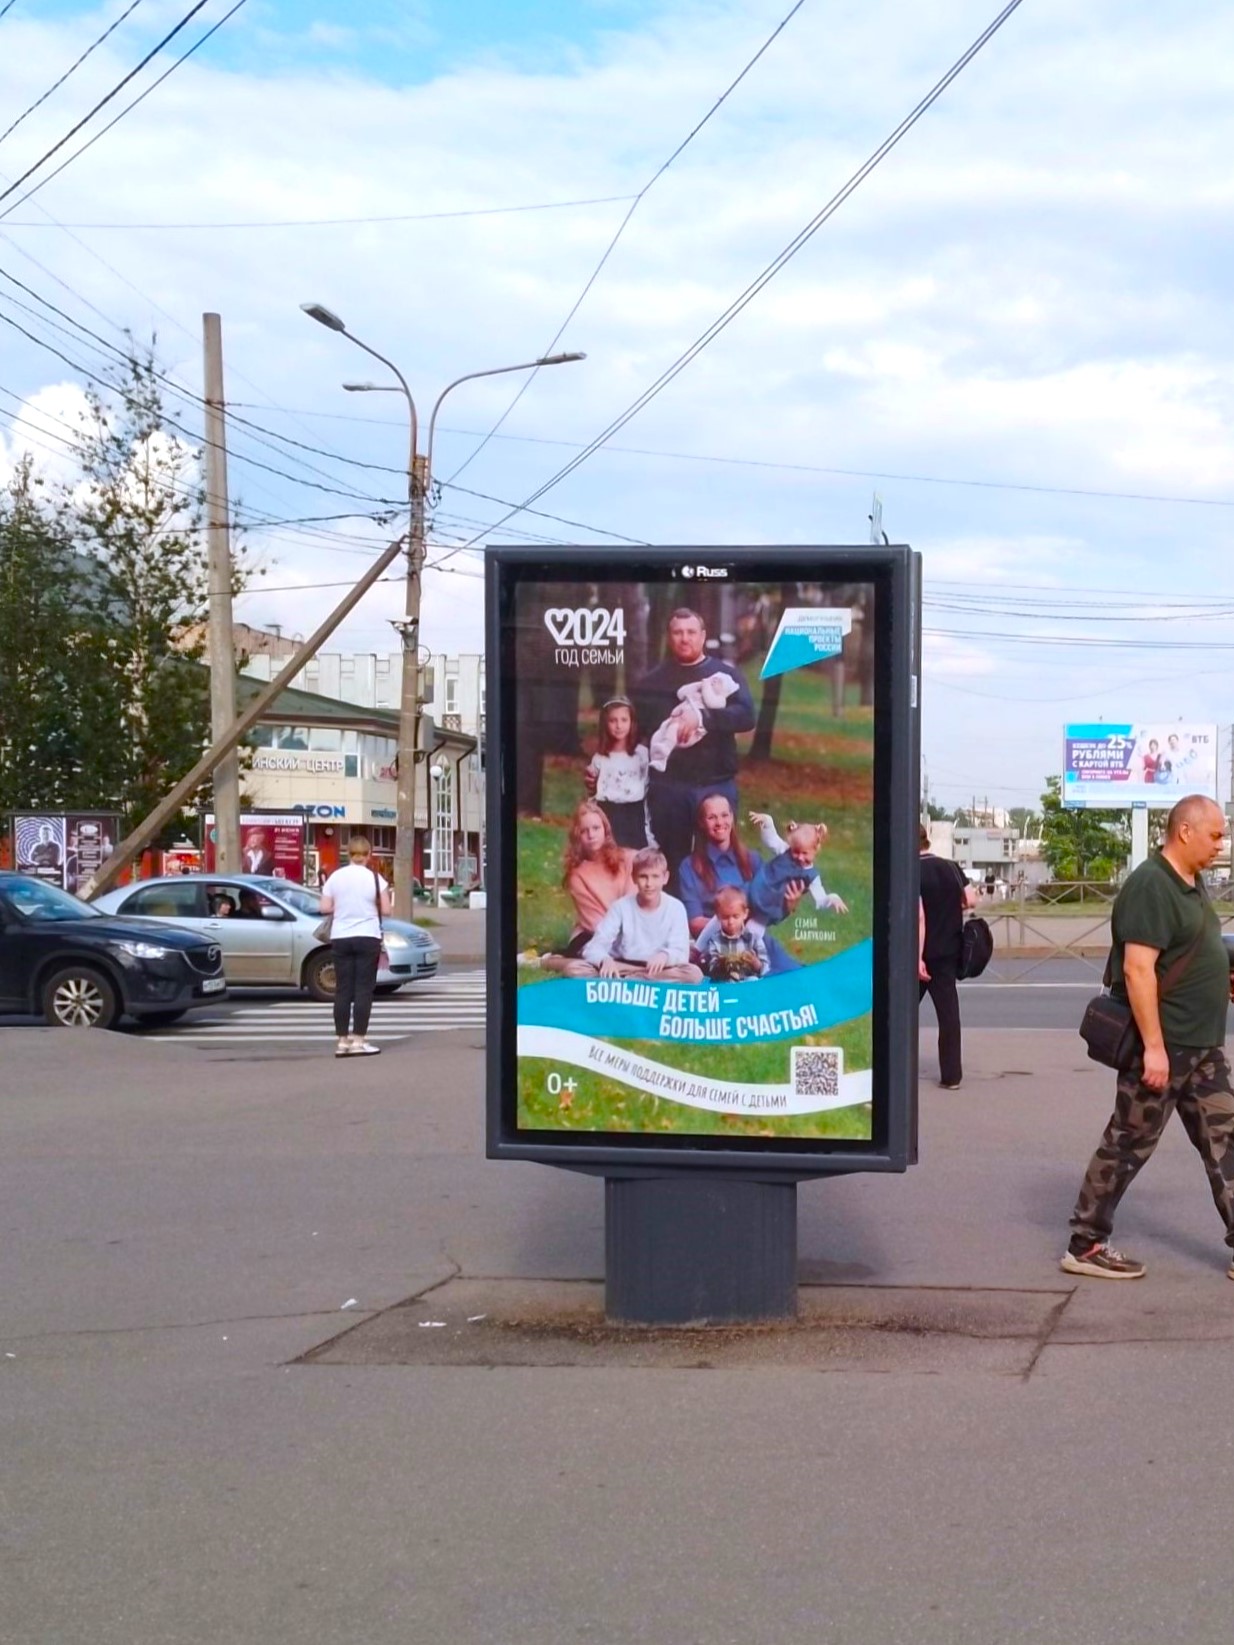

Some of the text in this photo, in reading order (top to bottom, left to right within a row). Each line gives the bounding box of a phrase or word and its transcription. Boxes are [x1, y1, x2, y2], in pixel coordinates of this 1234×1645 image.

[696, 565, 728, 577] Russ
[546, 607, 627, 646] 2024
[555, 648, 624, 668] ГОД СЕМЬИ
[1191, 735, 1209, 744] ВТБ
[252, 756, 344, 774] ИНСКИЙ ЦЕНТР
[1072, 749, 1125, 760] РУБЛЯМИ
[586, 981, 661, 1009] БОЛЬШЕ
[662, 986, 720, 1013] ДЕТЕЙ
[659, 1003, 819, 1041] БОЛЬШЕ СЧАСТЬЯ!
[547, 1072, 578, 1094] 0+
[588, 1044, 605, 1062] ВСЕ
[604, 1053, 631, 1072] МЕРЫ
[631, 1064, 687, 1092] ПОДДЕРЖКИ
[686, 1083, 708, 1099] ДЛЯ
[708, 1088, 740, 1106] СЕМЕЙ
[748, 1094, 788, 1109] ДЕТЬМИ
